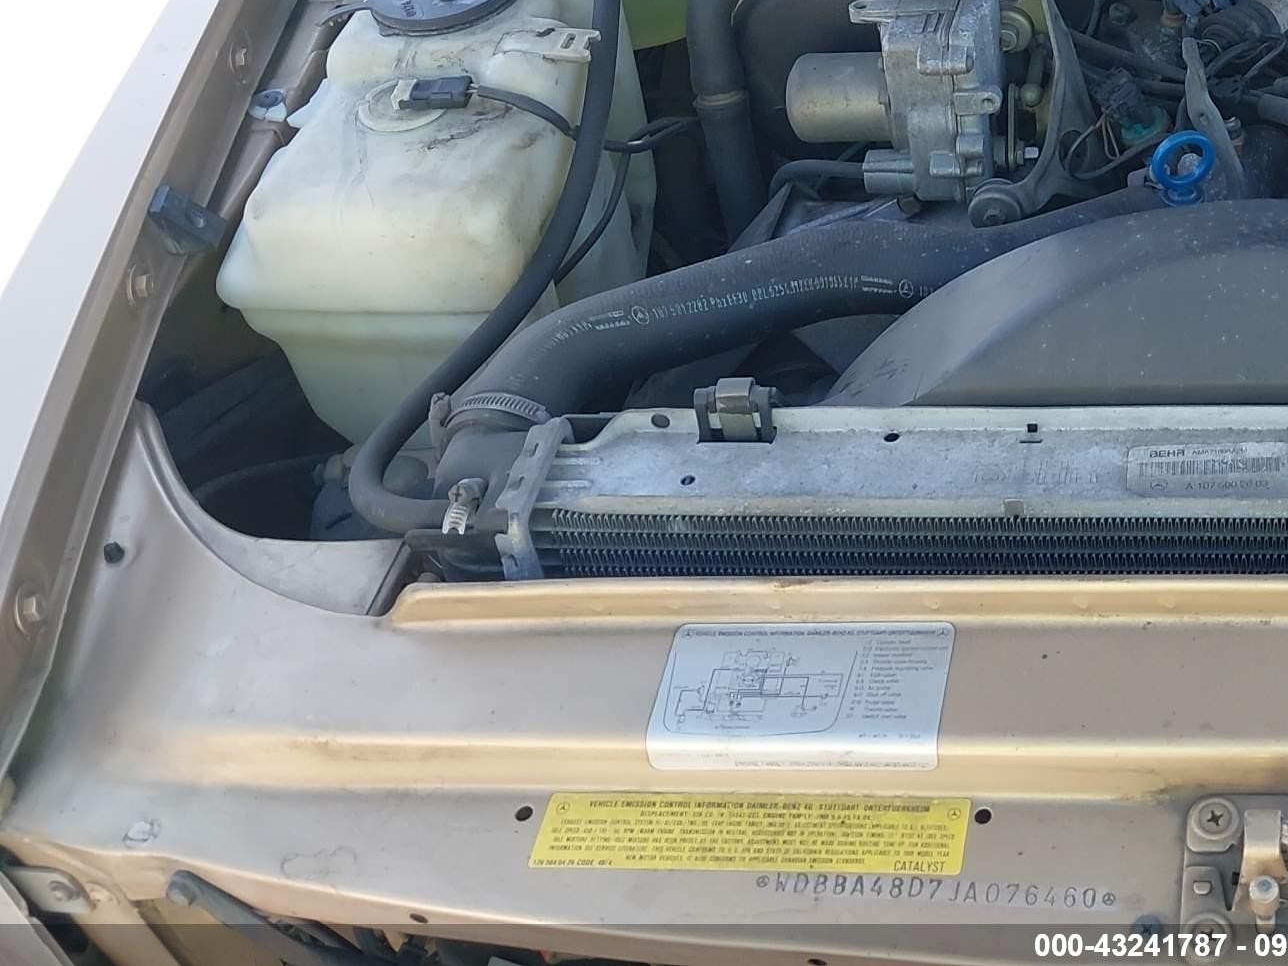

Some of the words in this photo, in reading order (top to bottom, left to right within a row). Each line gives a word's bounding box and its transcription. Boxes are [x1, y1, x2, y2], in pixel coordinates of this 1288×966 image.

[1150, 449, 1185, 458] BEHR
[589, 800, 618, 808] VEHICLE
[620, 800, 656, 809] EMISSION
[659, 801, 691, 809] CONTROL
[893, 860, 946, 872] CATALYST
